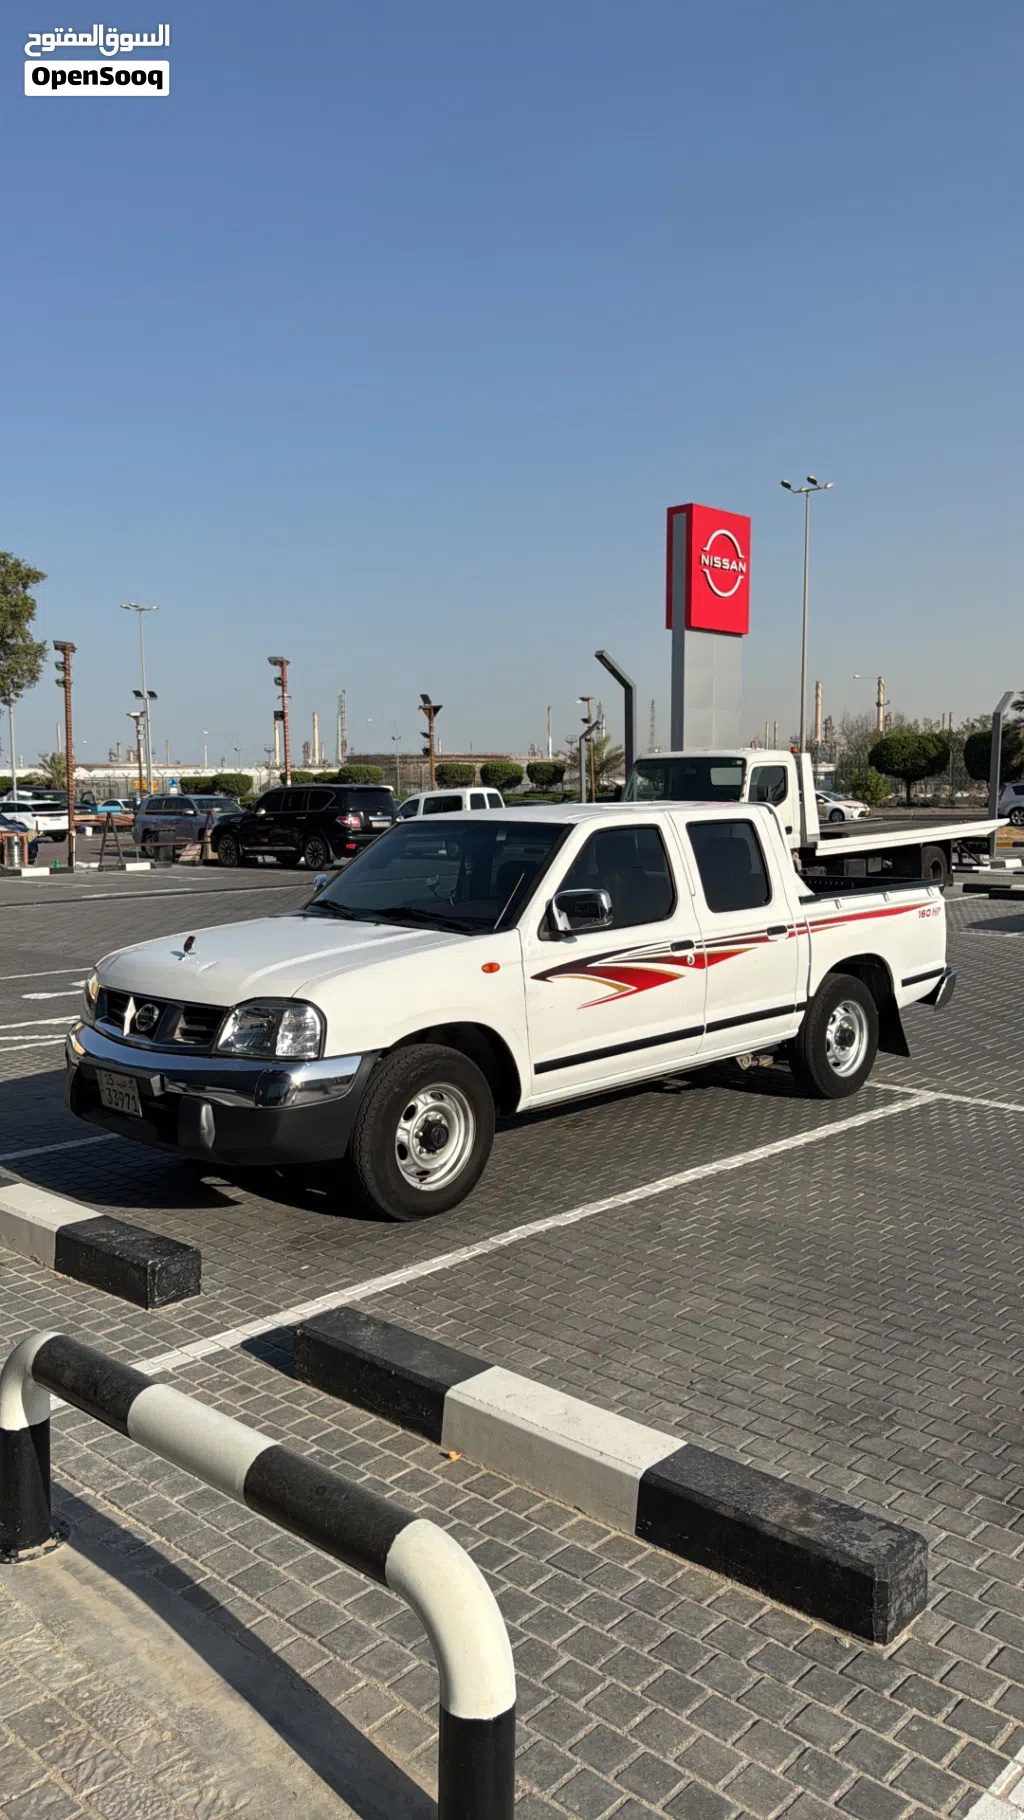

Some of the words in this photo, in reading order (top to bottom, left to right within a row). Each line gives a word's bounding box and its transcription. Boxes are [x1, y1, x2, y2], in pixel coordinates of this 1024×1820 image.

[700, 553, 747, 573] NISSAN
[918, 908, 932, 919] 160
[104, 1073, 114, 1086] 15
[105, 1087, 139, 1113] 33971
